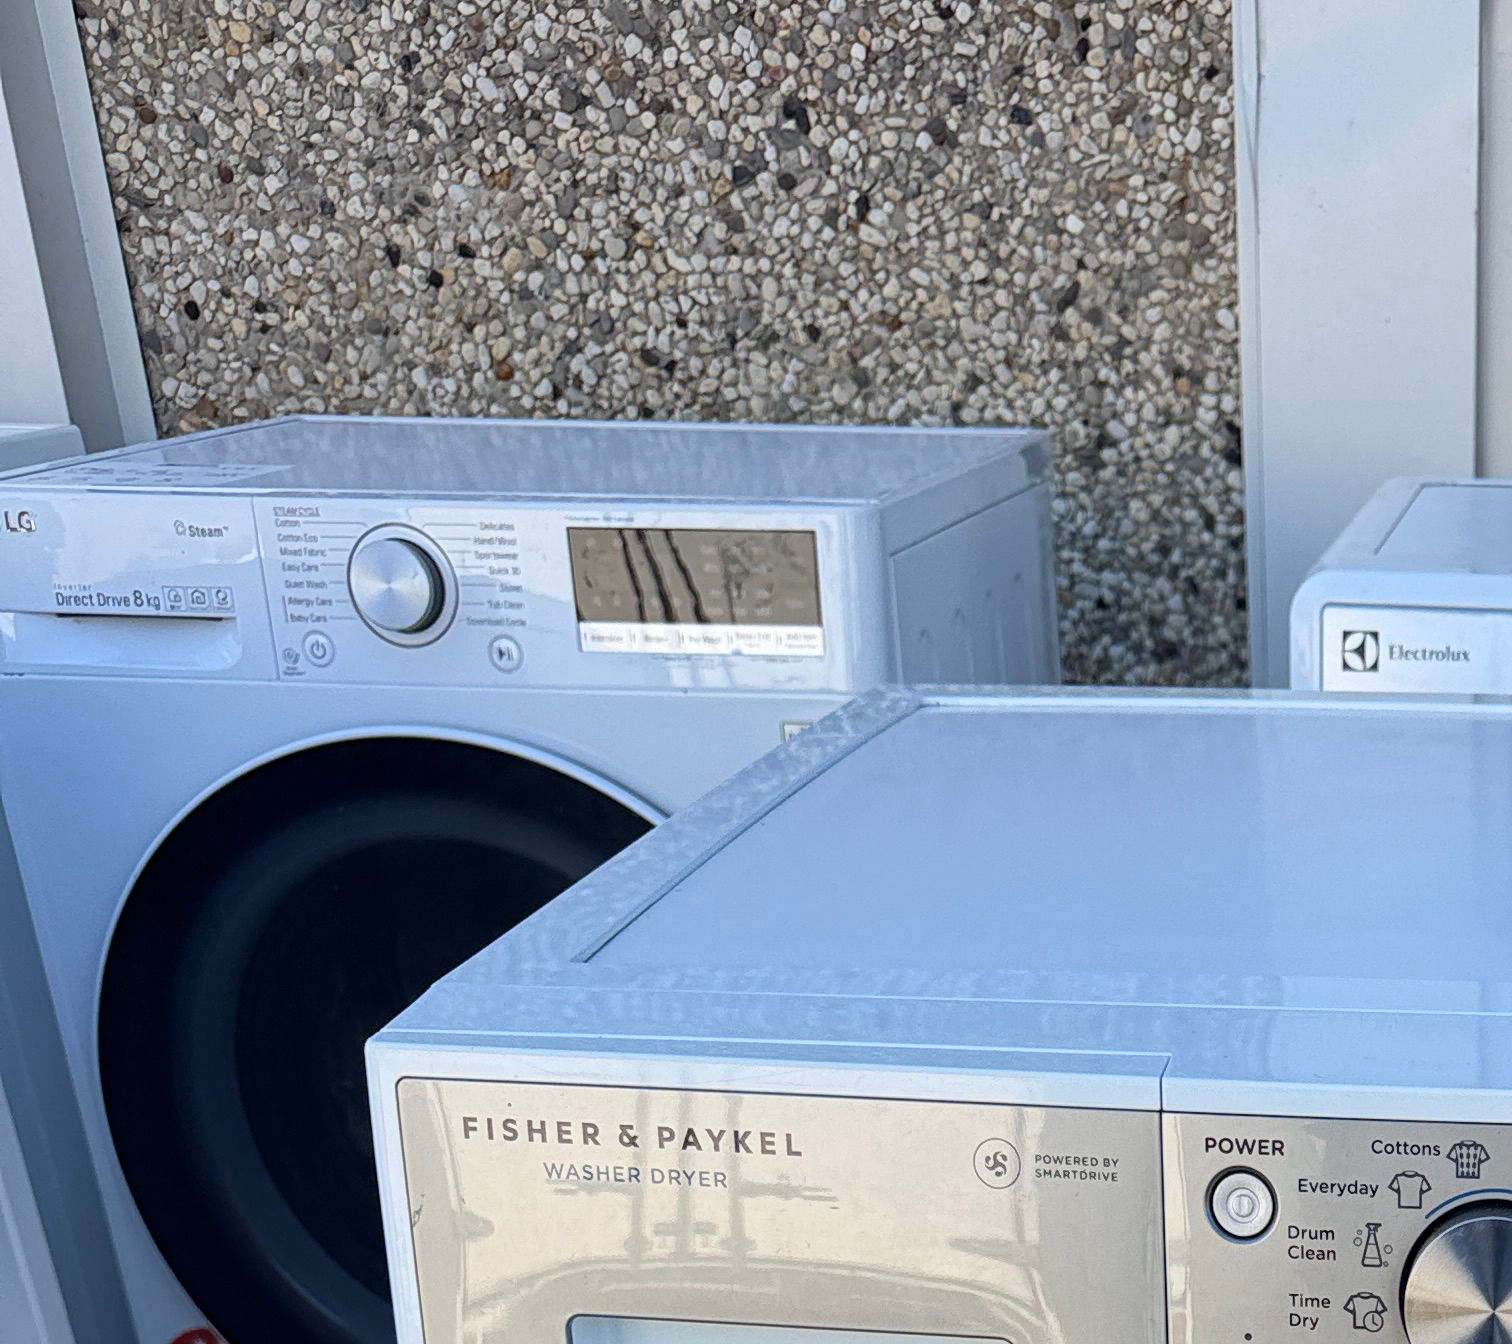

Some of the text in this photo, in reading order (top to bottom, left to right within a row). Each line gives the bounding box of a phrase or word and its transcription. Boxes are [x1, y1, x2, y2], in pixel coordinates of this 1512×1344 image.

[4, 510, 36, 533] LG
[55, 590, 161, 610] Direct Drive 8 kg
[1388, 644, 1470, 663] Electrolux
[462, 1116, 803, 1157] FISHER & PAYKEL
[1204, 1137, 1285, 1157] POWER
[1371, 1139, 1441, 1157] Cottons
[1034, 1154, 1119, 1168] POWERED BY
[542, 1161, 728, 1190] WASHER DRYER
[1034, 1168, 1119, 1183] SMARTDRIVE
[1298, 1179, 1380, 1198] Everyday
[1287, 1225, 1336, 1241] Drum
[1287, 1245, 1337, 1261] Clean
[1289, 1293, 1331, 1310] Time
[1289, 1313, 1319, 1330] Dry
